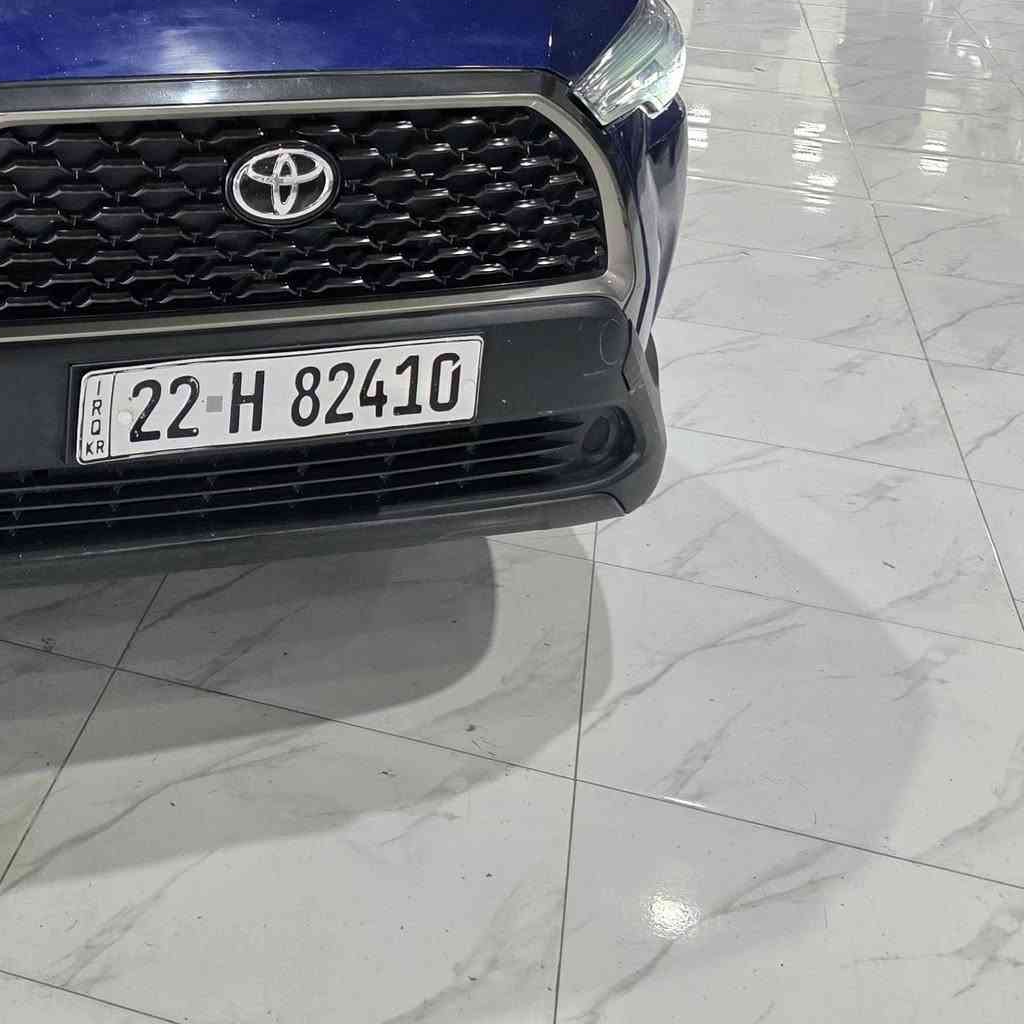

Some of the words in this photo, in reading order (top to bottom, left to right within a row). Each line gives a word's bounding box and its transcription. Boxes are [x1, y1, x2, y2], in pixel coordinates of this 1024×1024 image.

[129, 375, 201, 443] 22
[228, 370, 265, 434] H
[291, 352, 461, 427] 82410
[85, 440, 105, 456] KR
